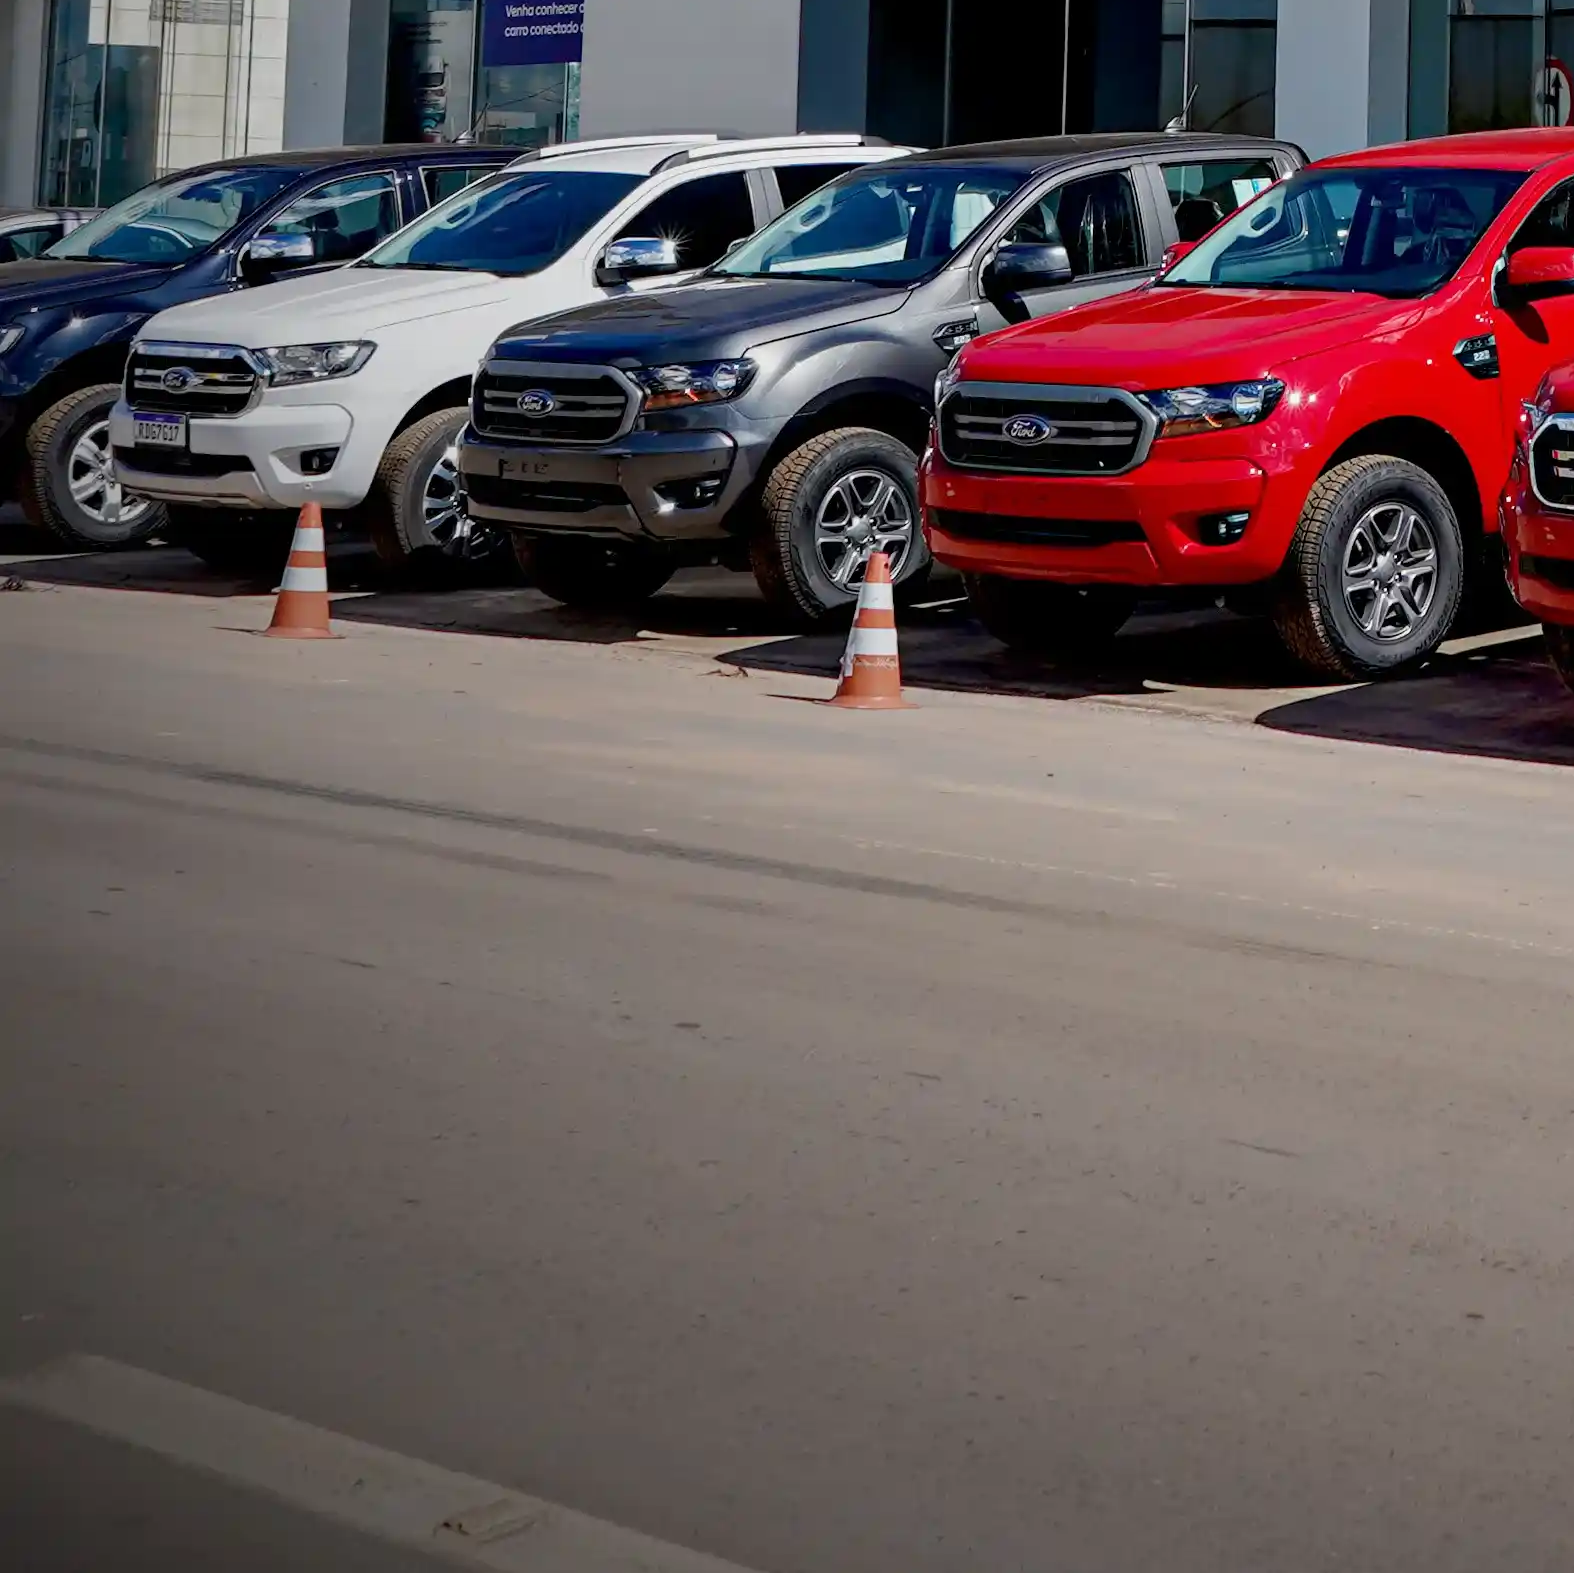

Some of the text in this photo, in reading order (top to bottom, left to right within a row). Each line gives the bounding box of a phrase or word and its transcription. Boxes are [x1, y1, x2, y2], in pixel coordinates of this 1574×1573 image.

[505, 4, 534, 17] Venha
[535, 2, 578, 16] conhecer
[504, 25, 529, 37] carro
[529, 21, 579, 35] conectado
[1010, 420, 1037, 437] Ford
